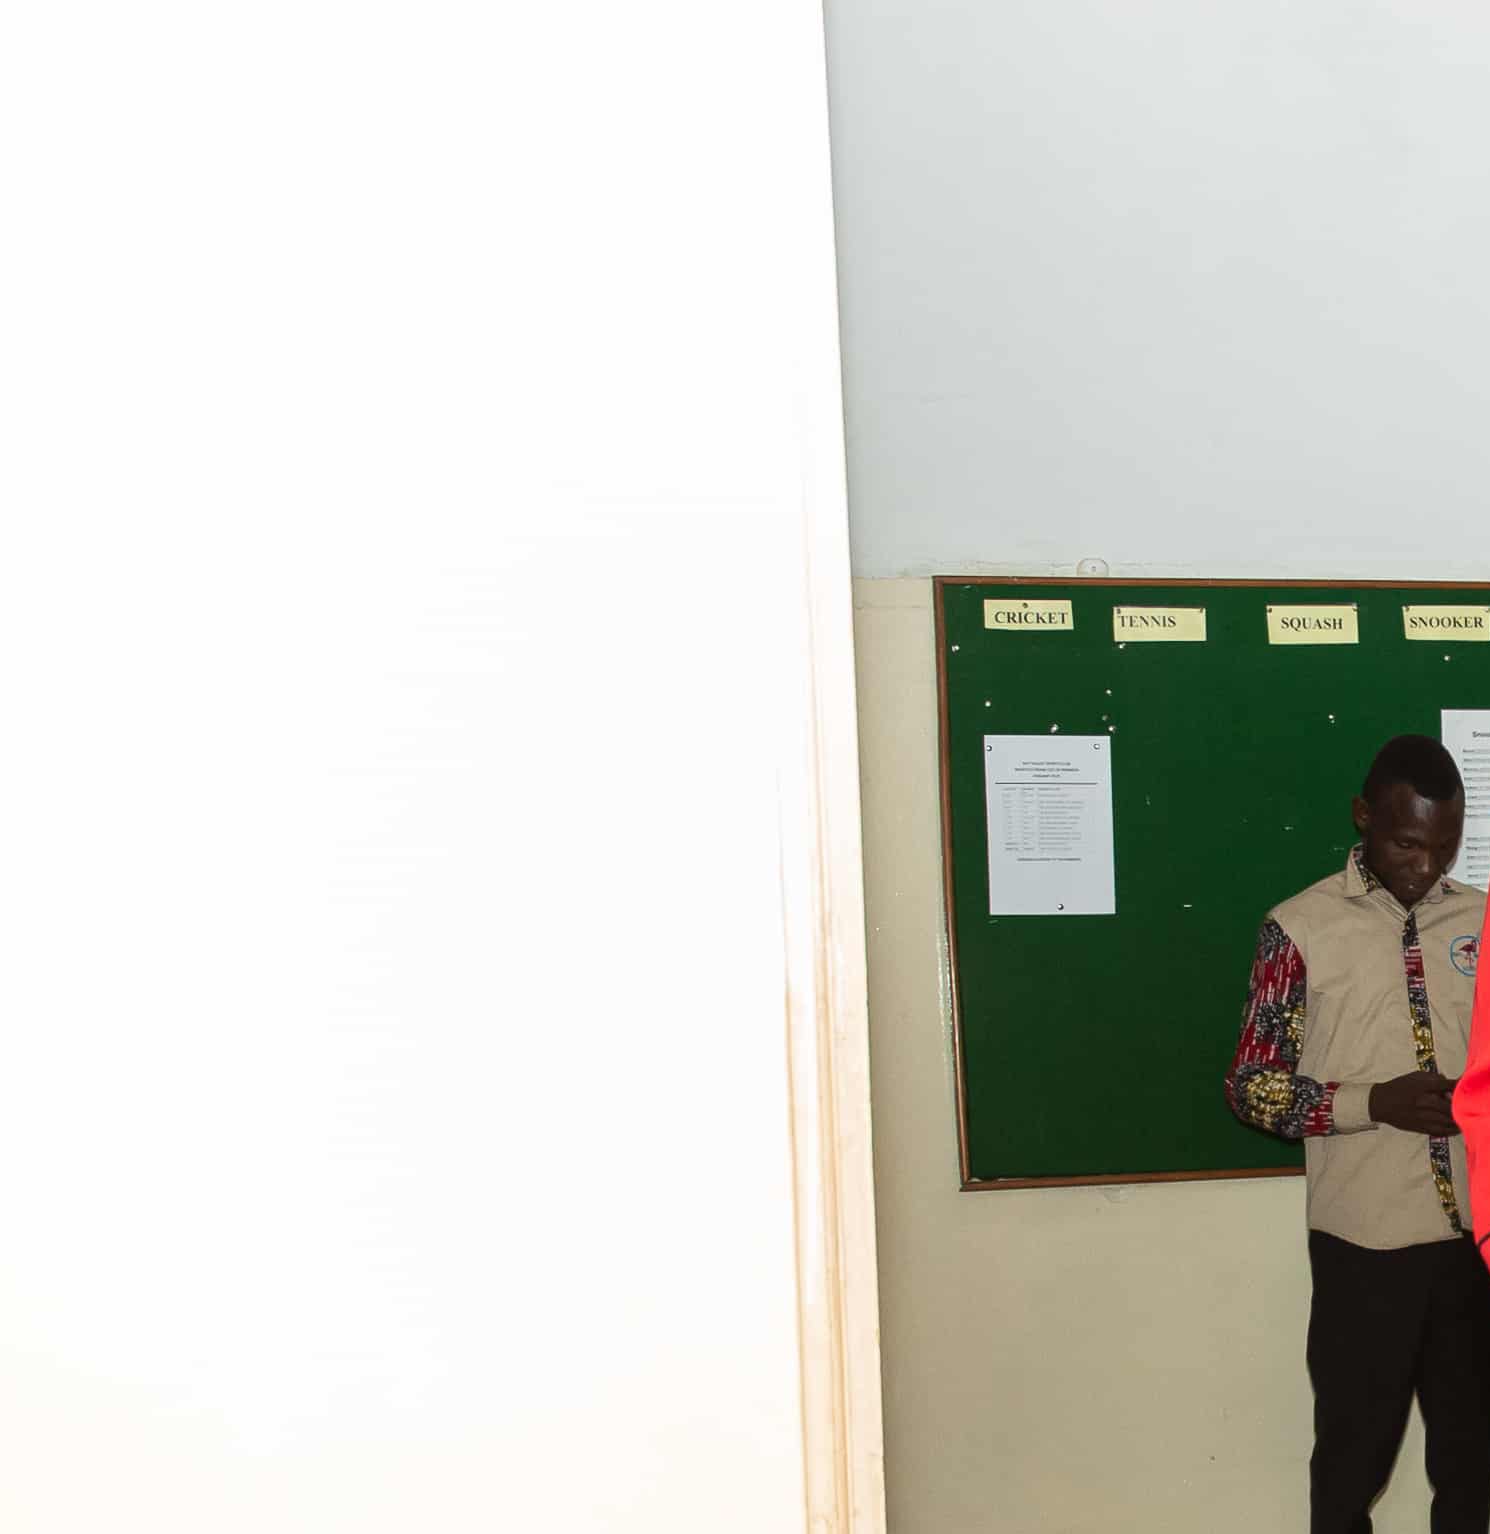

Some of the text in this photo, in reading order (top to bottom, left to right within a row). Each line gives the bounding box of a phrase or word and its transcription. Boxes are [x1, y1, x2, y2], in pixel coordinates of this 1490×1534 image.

[994, 610, 1069, 625] CRICKET
[1117, 614, 1177, 628] TENNIS
[1280, 616, 1344, 631] SQUASH
[1409, 615, 1485, 630] SNOOKER
